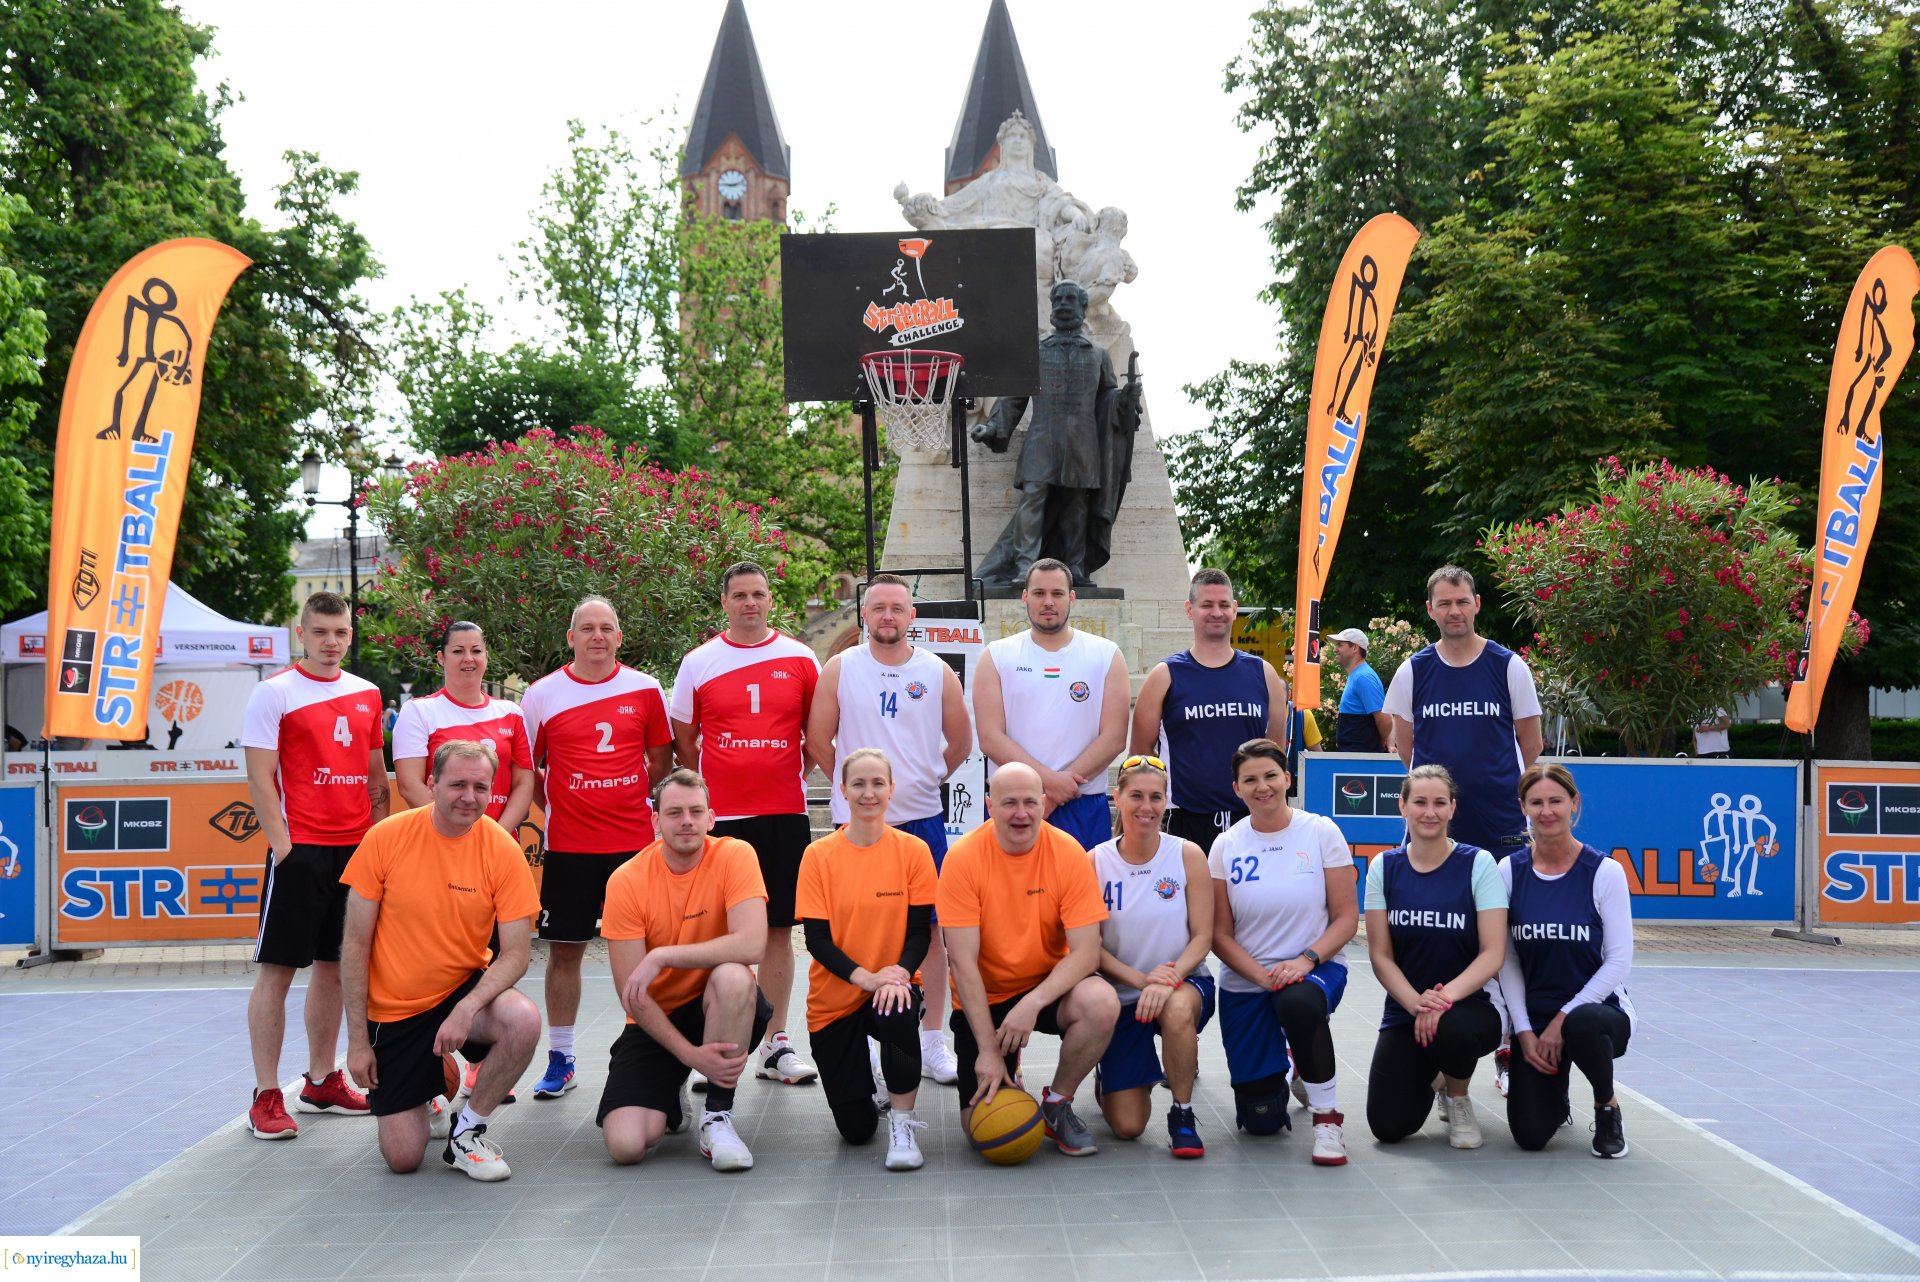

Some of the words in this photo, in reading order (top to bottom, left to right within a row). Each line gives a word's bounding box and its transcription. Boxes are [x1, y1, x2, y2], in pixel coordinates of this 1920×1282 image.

[897, 319, 960, 343] CHALLENGE
[75, 546, 98, 597] TOTI
[174, 643, 236, 651] VERSENYIRODA
[746, 684, 760, 714] 1
[879, 691, 898, 718] 14
[1422, 701, 1500, 718] MICHELIN
[1185, 702, 1262, 720] MICHELIN
[333, 715, 353, 747] 4
[595, 721, 615, 752] 2
[584, 774, 639, 789] marso
[123, 820, 163, 828] MKOSZ
[1230, 856, 1260, 885] 52
[1103, 880, 1123, 911] 41
[541, 909, 550, 928] 2
[1387, 909, 1466, 930] MICHELIN
[1511, 923, 1590, 942] MICHELIN
